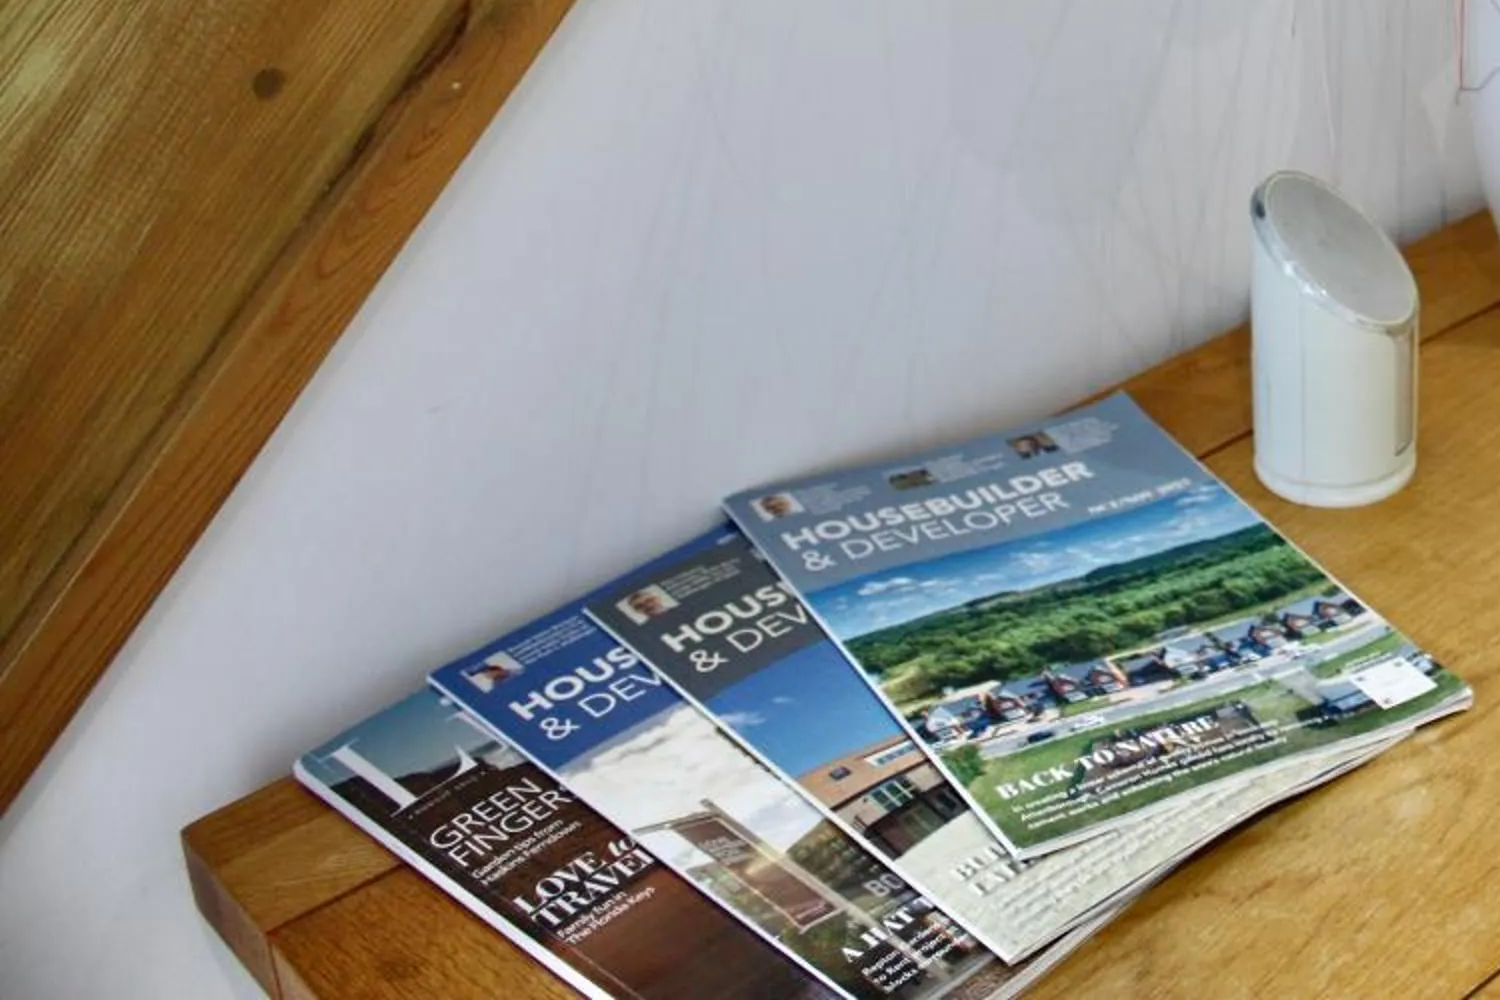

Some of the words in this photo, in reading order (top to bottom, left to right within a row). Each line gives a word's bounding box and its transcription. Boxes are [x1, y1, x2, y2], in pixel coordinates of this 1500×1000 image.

[781, 460, 1095, 552] HOUSEBUILDER
[801, 546, 836, 574] &
[844, 491, 1071, 562] DEVELOPER
[660, 581, 795, 652] HOUS
[688, 649, 729, 673] &
[539, 716, 581, 740] &
[995, 763, 1075, 800] BACK
[1075, 744, 1116, 771] TO
[1115, 714, 1220, 756] NATURE
[429, 777, 543, 850] GREEN
[513, 851, 605, 916] LOVE
